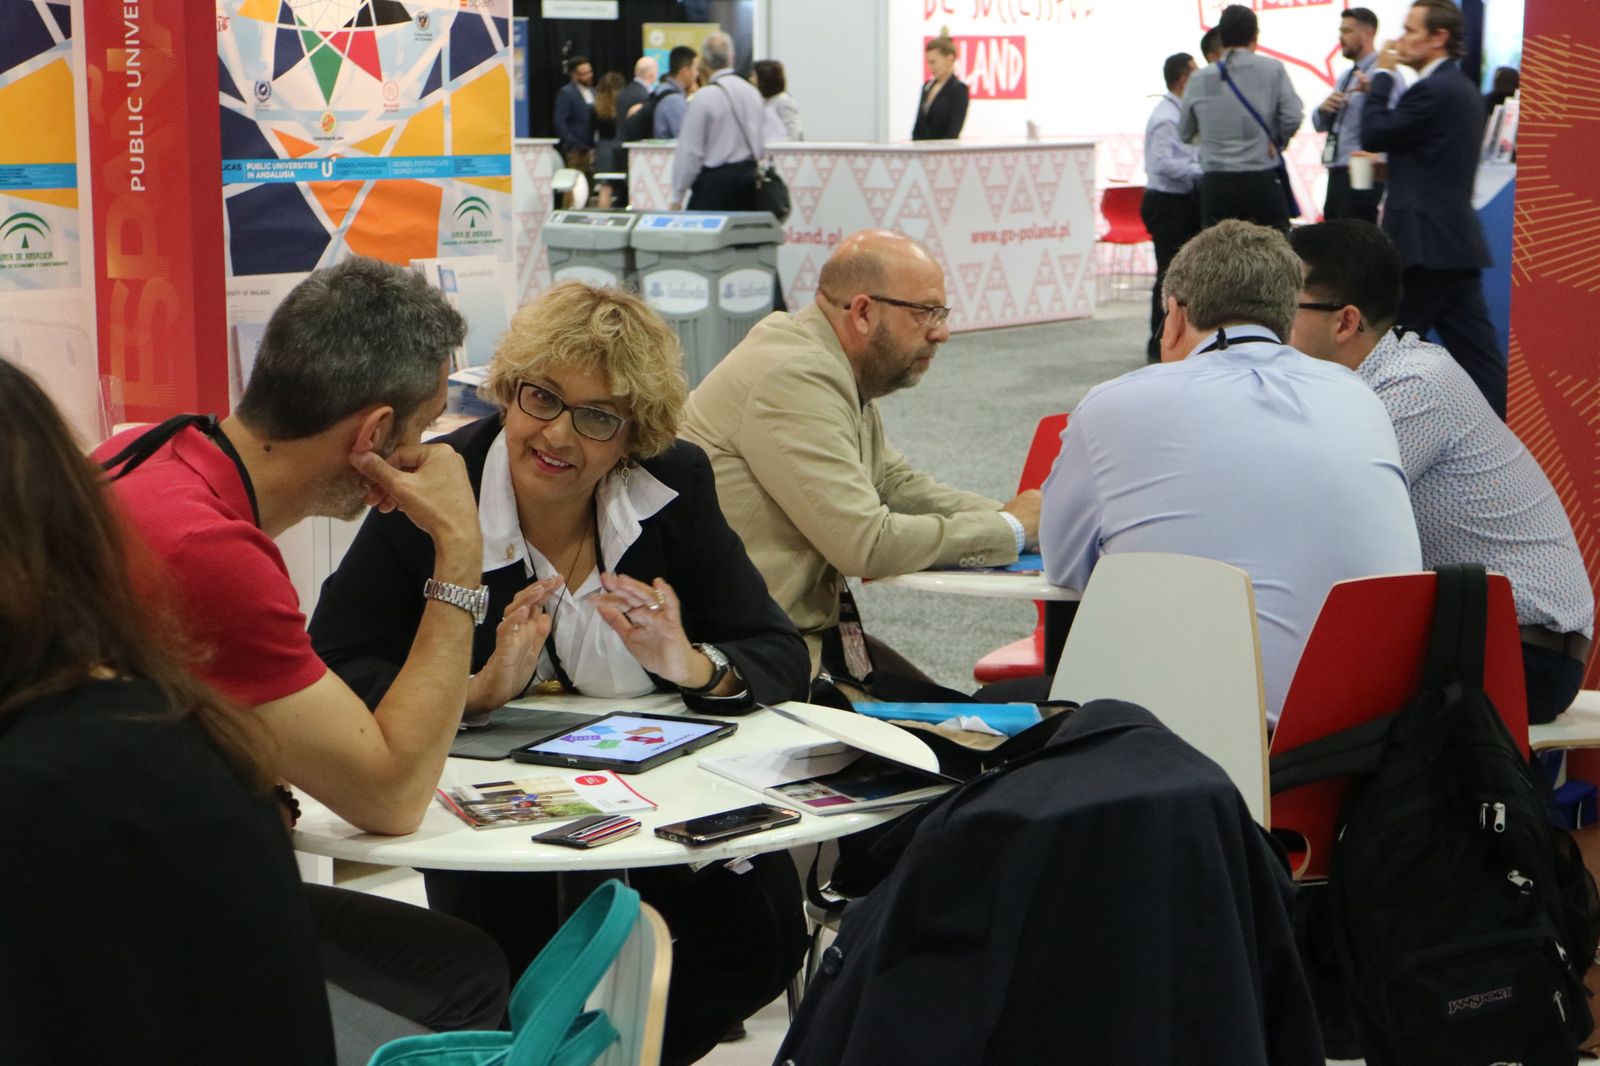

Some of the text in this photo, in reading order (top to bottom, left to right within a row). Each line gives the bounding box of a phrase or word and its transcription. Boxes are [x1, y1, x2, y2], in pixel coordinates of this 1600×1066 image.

[951, 37, 1024, 97] LAND
[123, 0, 146, 192] PUBLIC UNIVE
[246, 161, 319, 171] PUBLIC UNIVERSITIES
[247, 170, 296, 179] IN ANDALUSIA
[783, 225, 843, 249] oland.pl
[971, 222, 1071, 246] www.go-poland.pl
